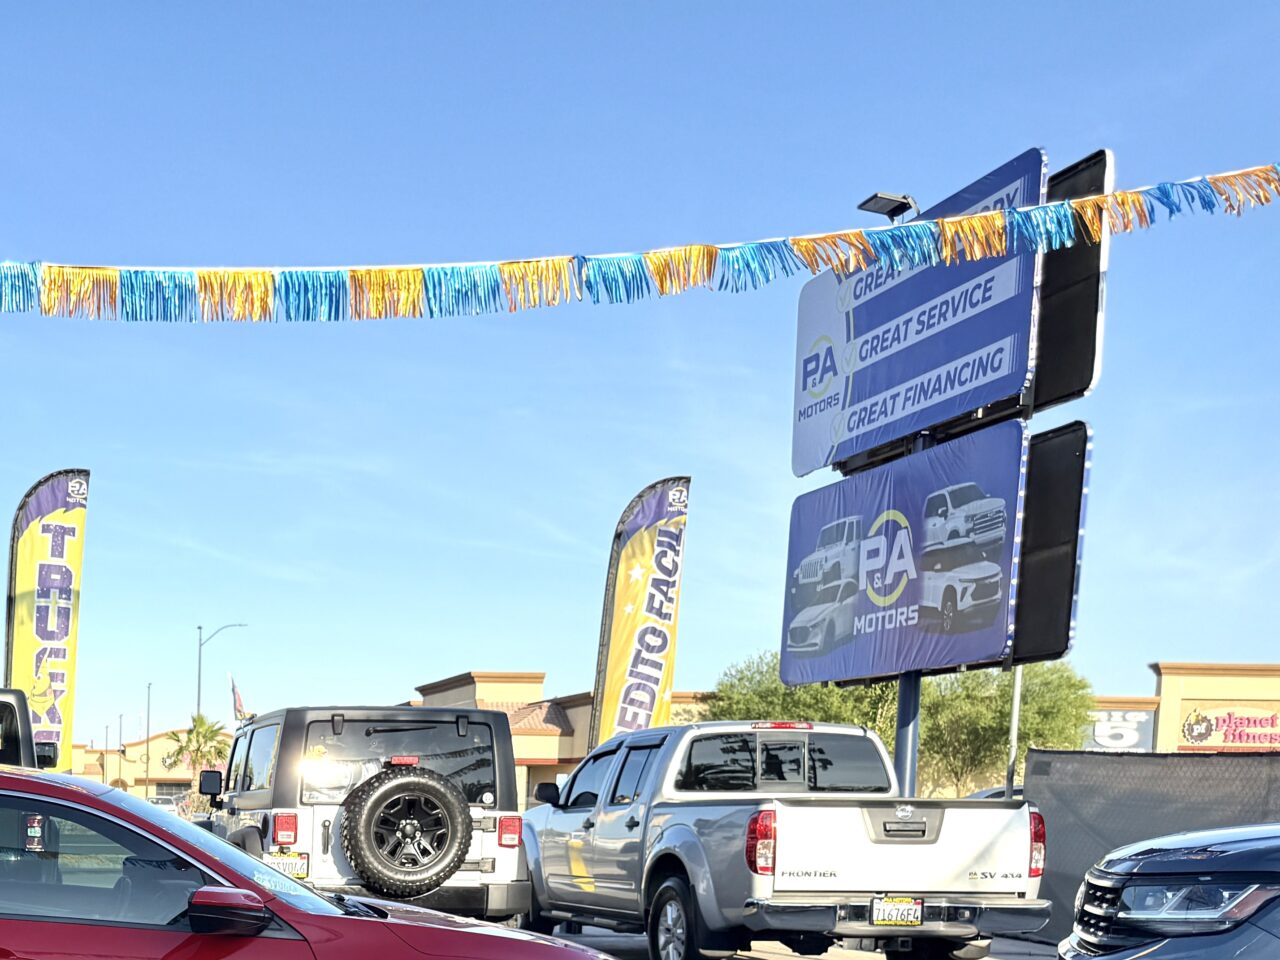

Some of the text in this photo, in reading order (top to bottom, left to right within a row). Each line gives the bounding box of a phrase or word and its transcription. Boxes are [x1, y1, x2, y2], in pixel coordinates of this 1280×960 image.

[859, 275, 996, 362] GREAT SERVICE
[846, 346, 1006, 433] GREAT FINANCING
[798, 392, 840, 422] MOTORS
[858, 527, 917, 591] P&A
[853, 605, 919, 635] MOTORS
[616, 626, 669, 735] EDITO
[1094, 721, 1139, 748] 5
[1215, 712, 1278, 731] planet
[1223, 729, 1280, 743] fitnes
[781, 870, 838, 878] FRONTIER
[980, 871, 997, 880] SV
[875, 907, 920, 922] 71676F4
